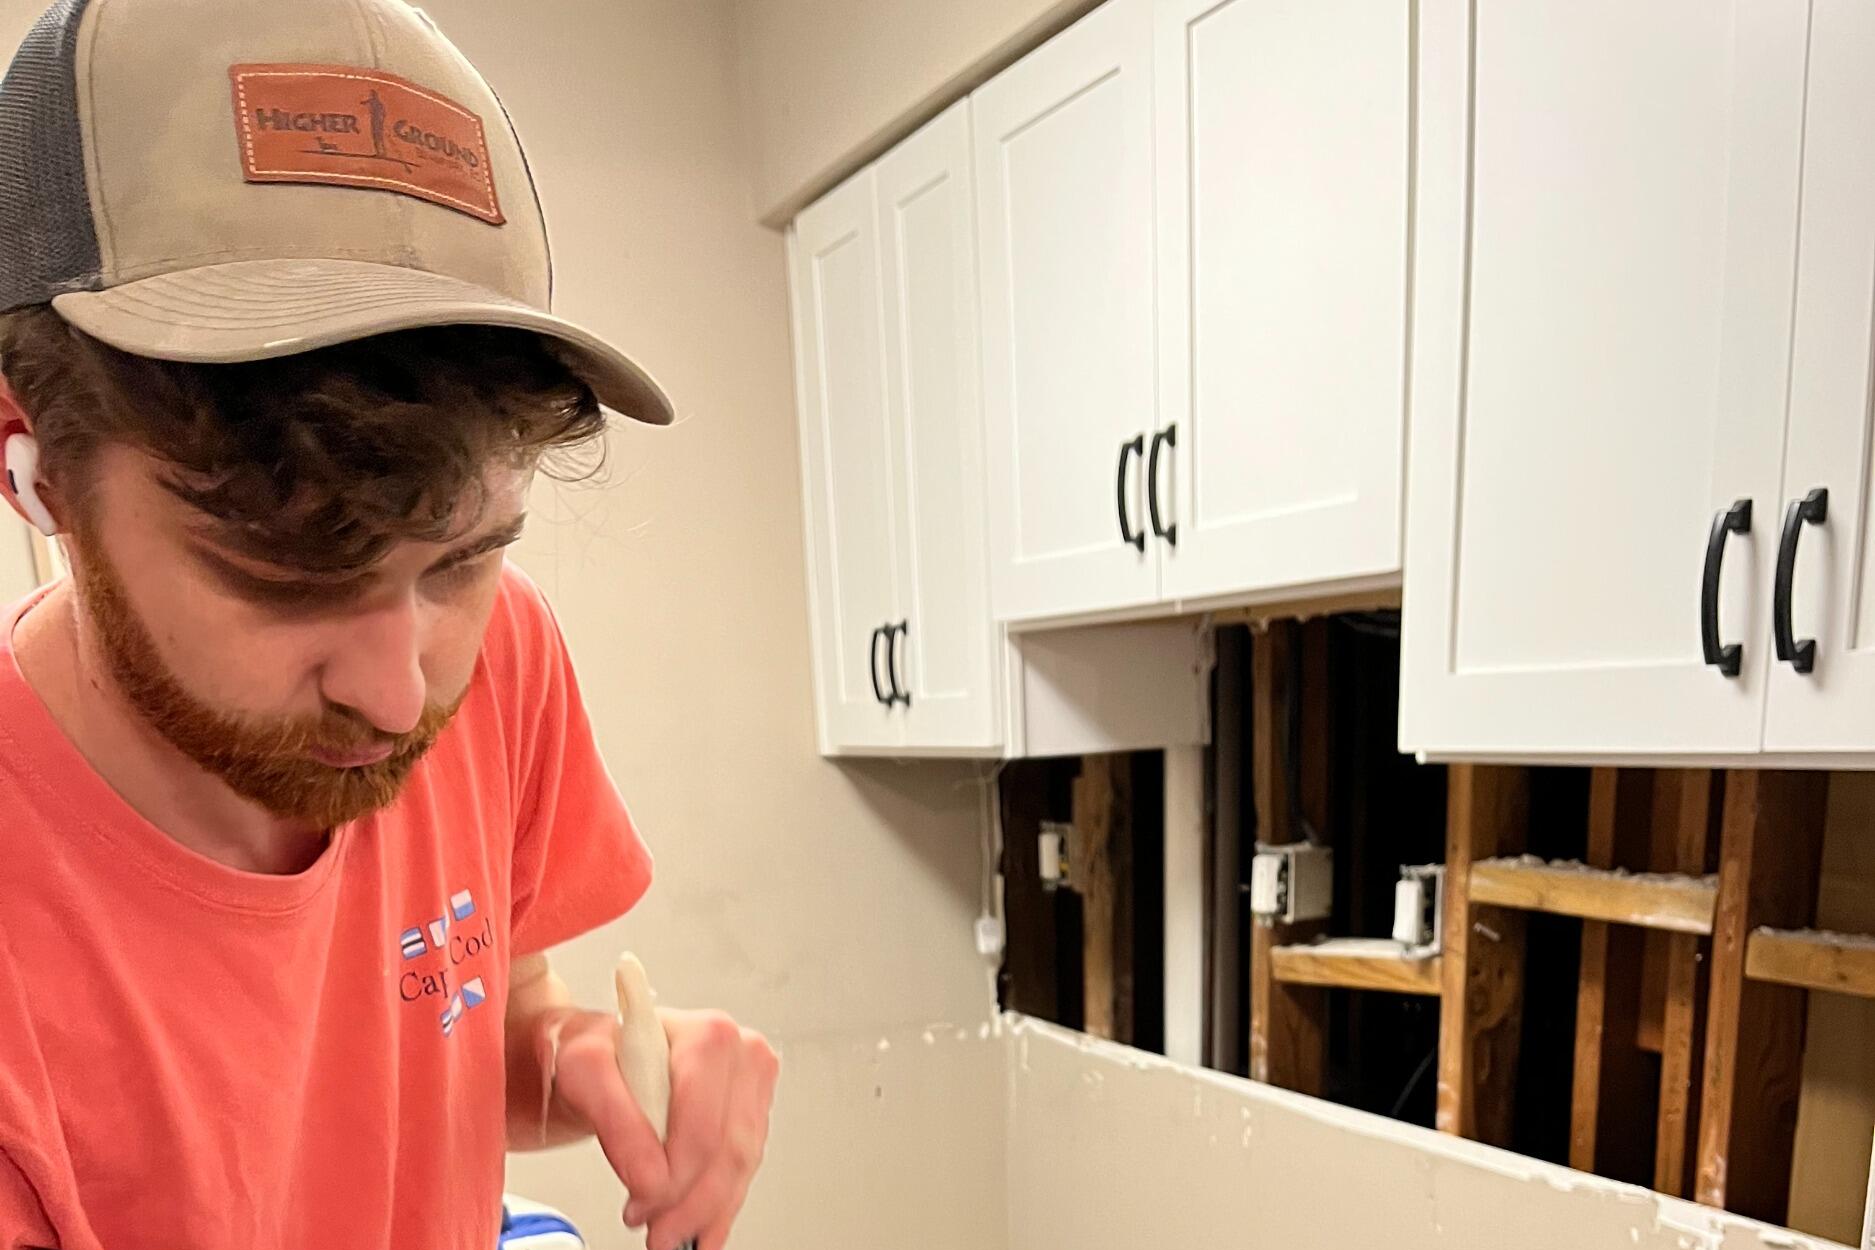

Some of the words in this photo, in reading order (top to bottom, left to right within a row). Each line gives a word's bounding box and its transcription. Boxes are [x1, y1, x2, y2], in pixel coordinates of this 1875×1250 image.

[256, 107, 361, 135] HIGHER
[393, 119, 479, 168] GROUND
[399, 969, 449, 1002] Cap
[450, 917, 494, 965] Cod
